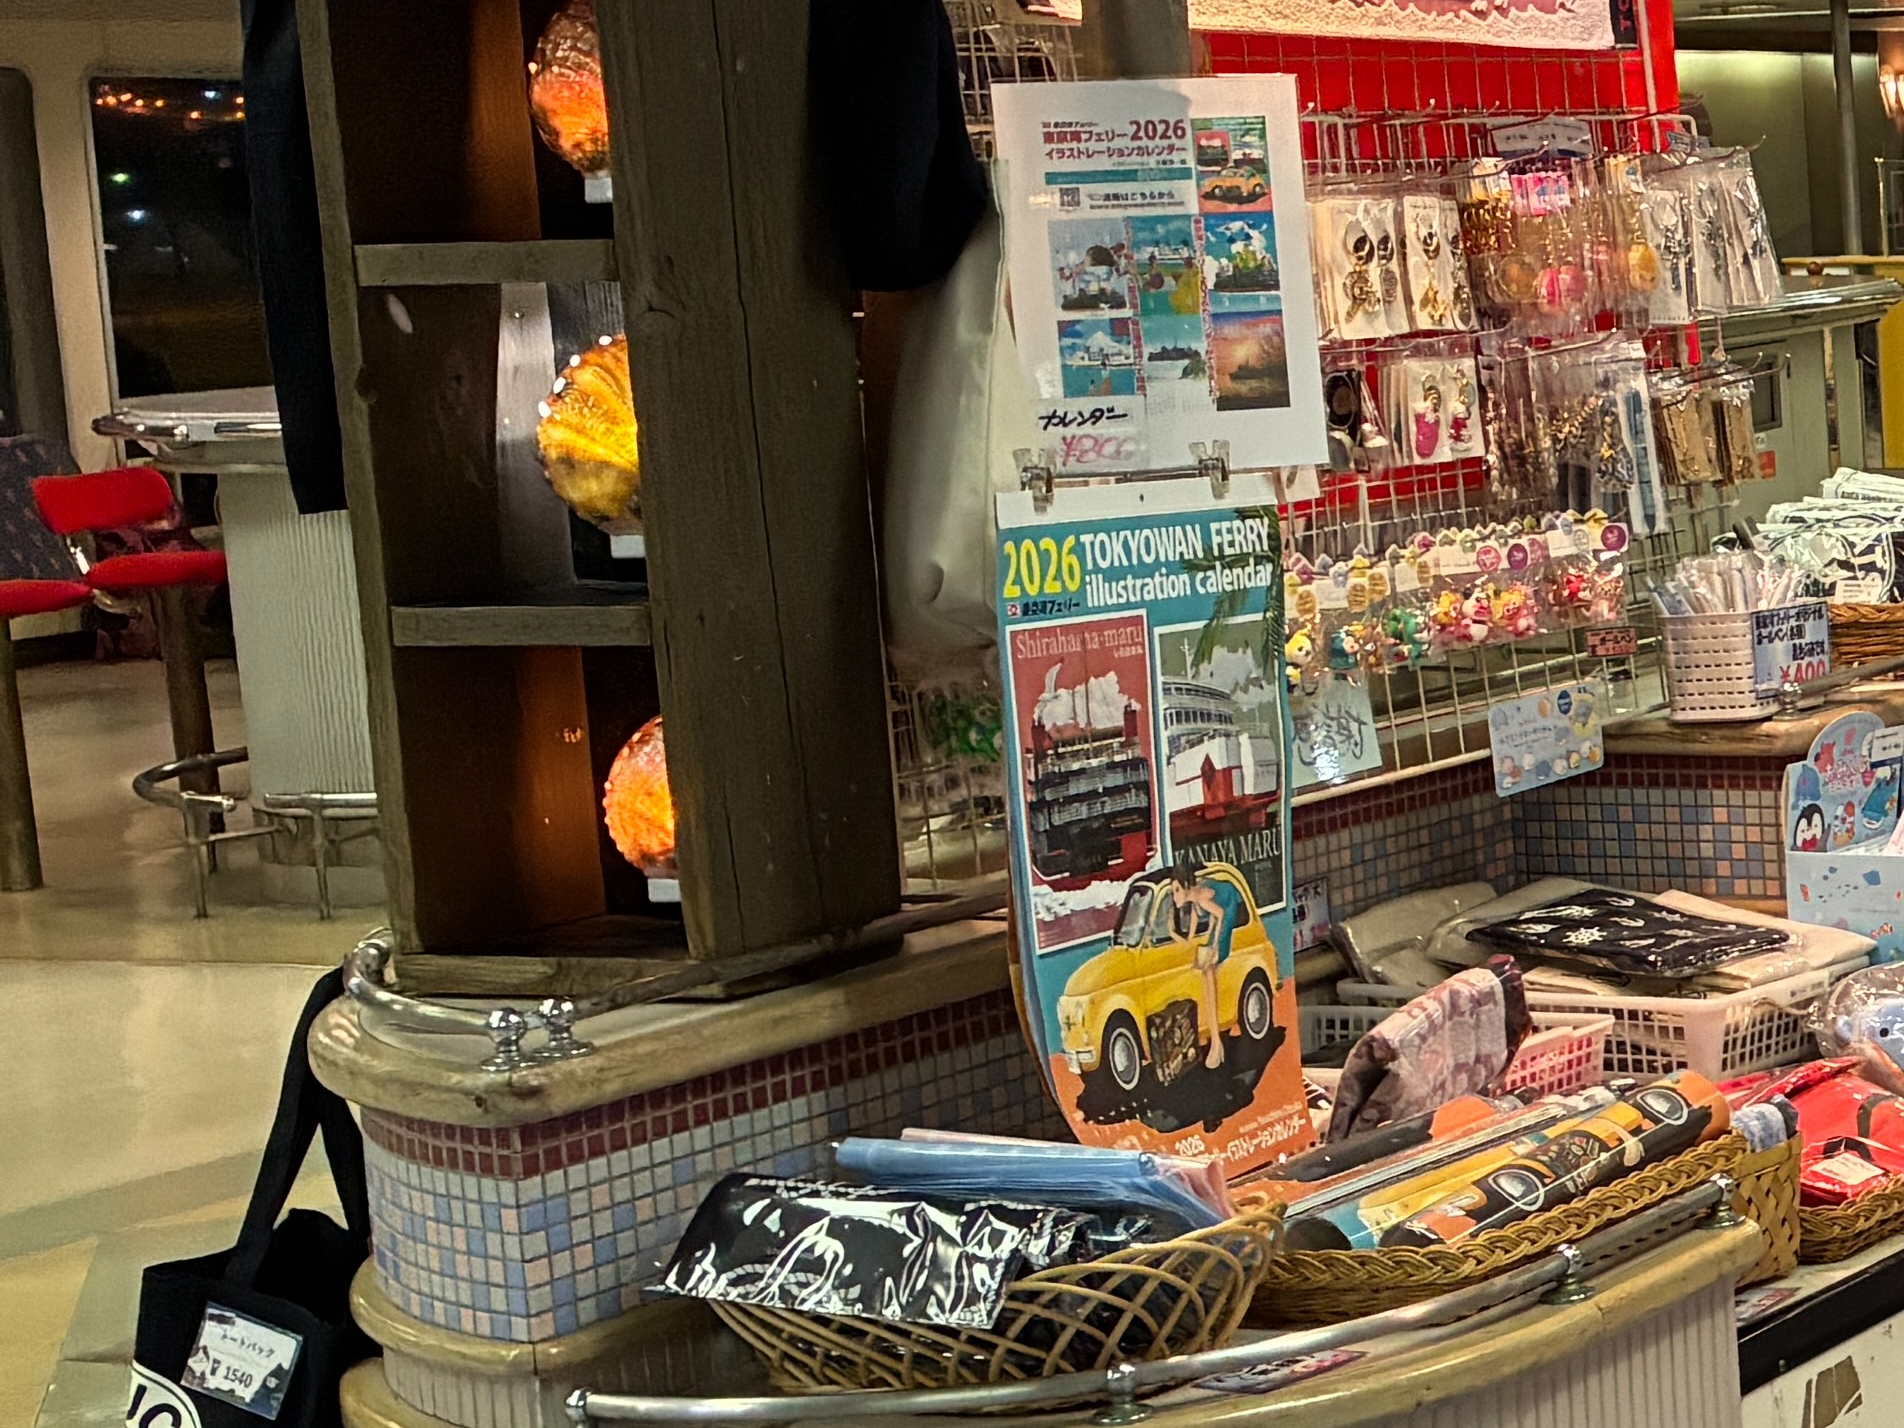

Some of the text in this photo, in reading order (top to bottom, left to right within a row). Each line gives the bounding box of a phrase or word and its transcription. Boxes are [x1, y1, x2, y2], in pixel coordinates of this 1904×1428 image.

[1128, 118, 1187, 141] 2026
[1045, 143, 1188, 160] イラストレーションカレンダー
[1037, 405, 1129, 432] カレンダー
[1002, 516, 1271, 599] 2026 TOKYOWAN FERRY
[1084, 554, 1274, 608] illustration calendar
[1779, 658, 1826, 684] ¥400
[1238, 826, 1283, 865] MARU
